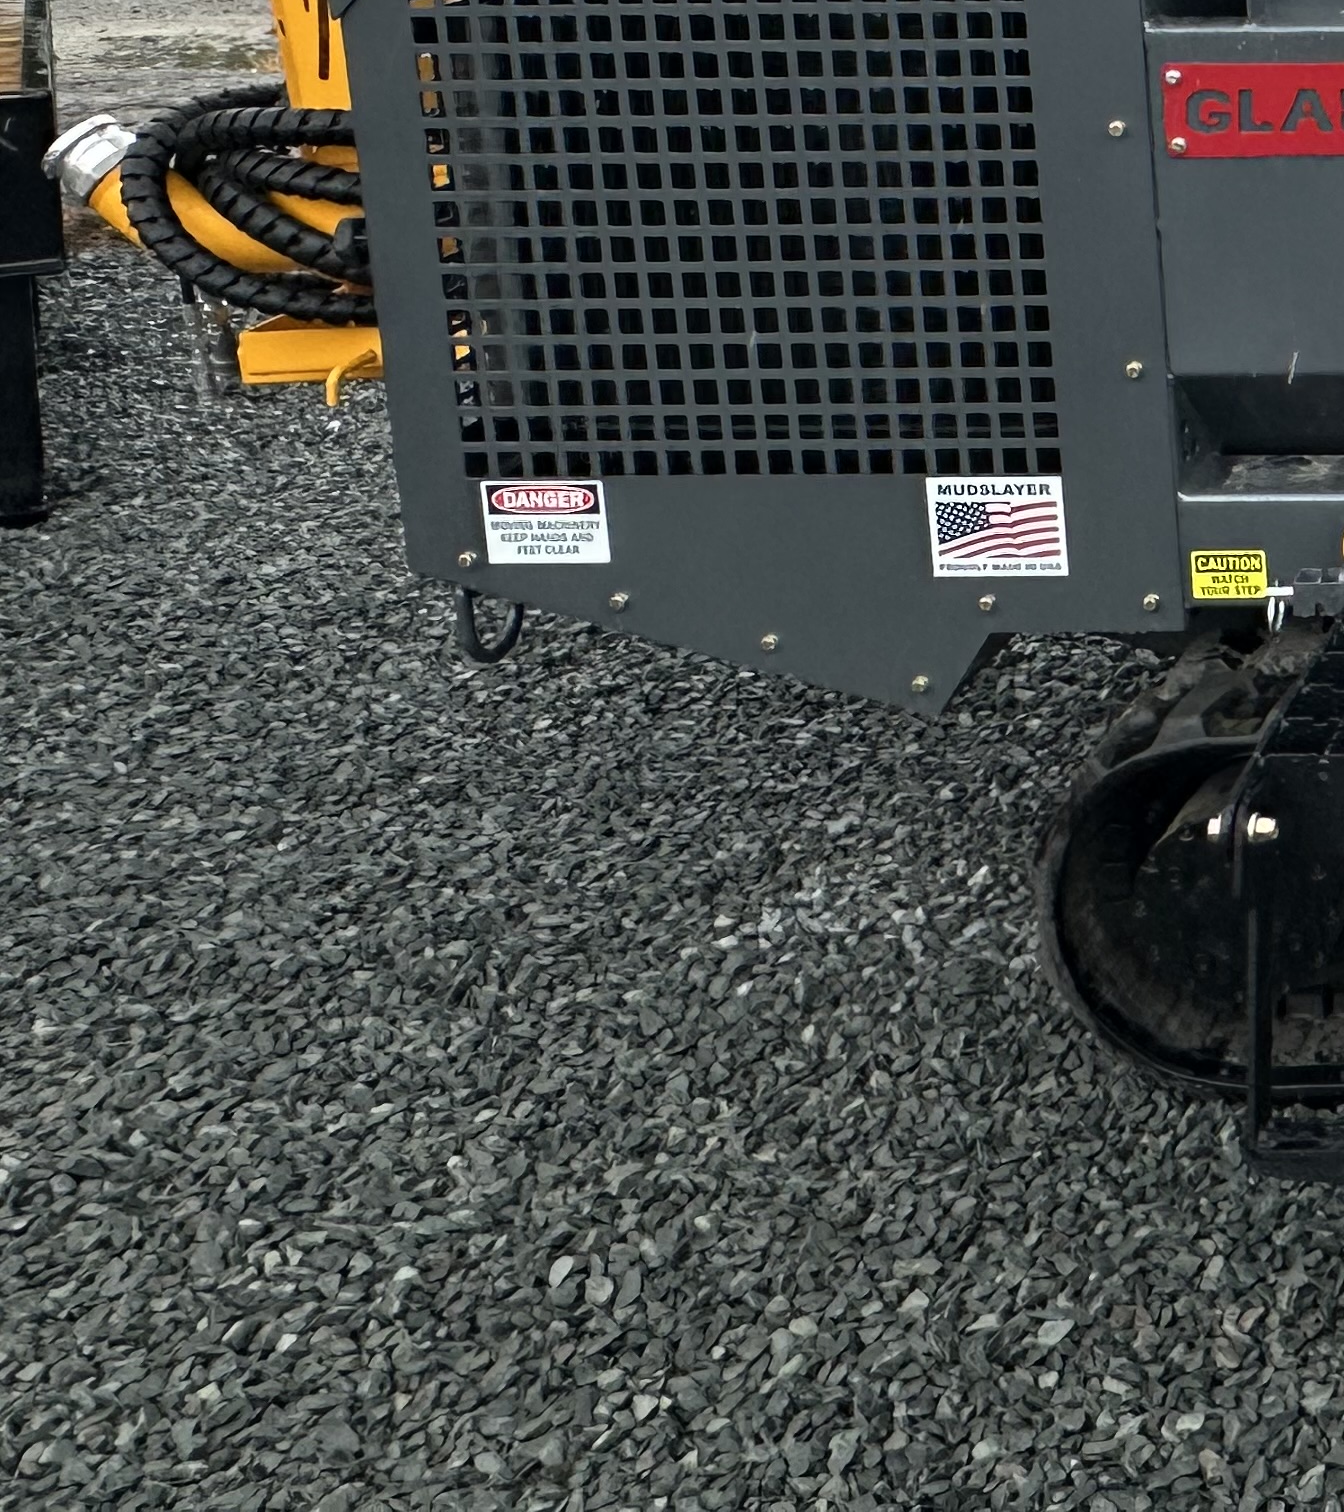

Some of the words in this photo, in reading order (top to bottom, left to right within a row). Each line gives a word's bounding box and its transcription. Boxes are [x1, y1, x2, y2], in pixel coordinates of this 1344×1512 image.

[937, 484, 1051, 495] MUDSLAYER
[502, 490, 585, 508] DANGER
[517, 545, 541, 555] FEET
[545, 545, 580, 555] CLEAR
[1197, 556, 1261, 571] CAUTION
[1211, 574, 1249, 584] WATCH
[1235, 585, 1261, 595] STEP
